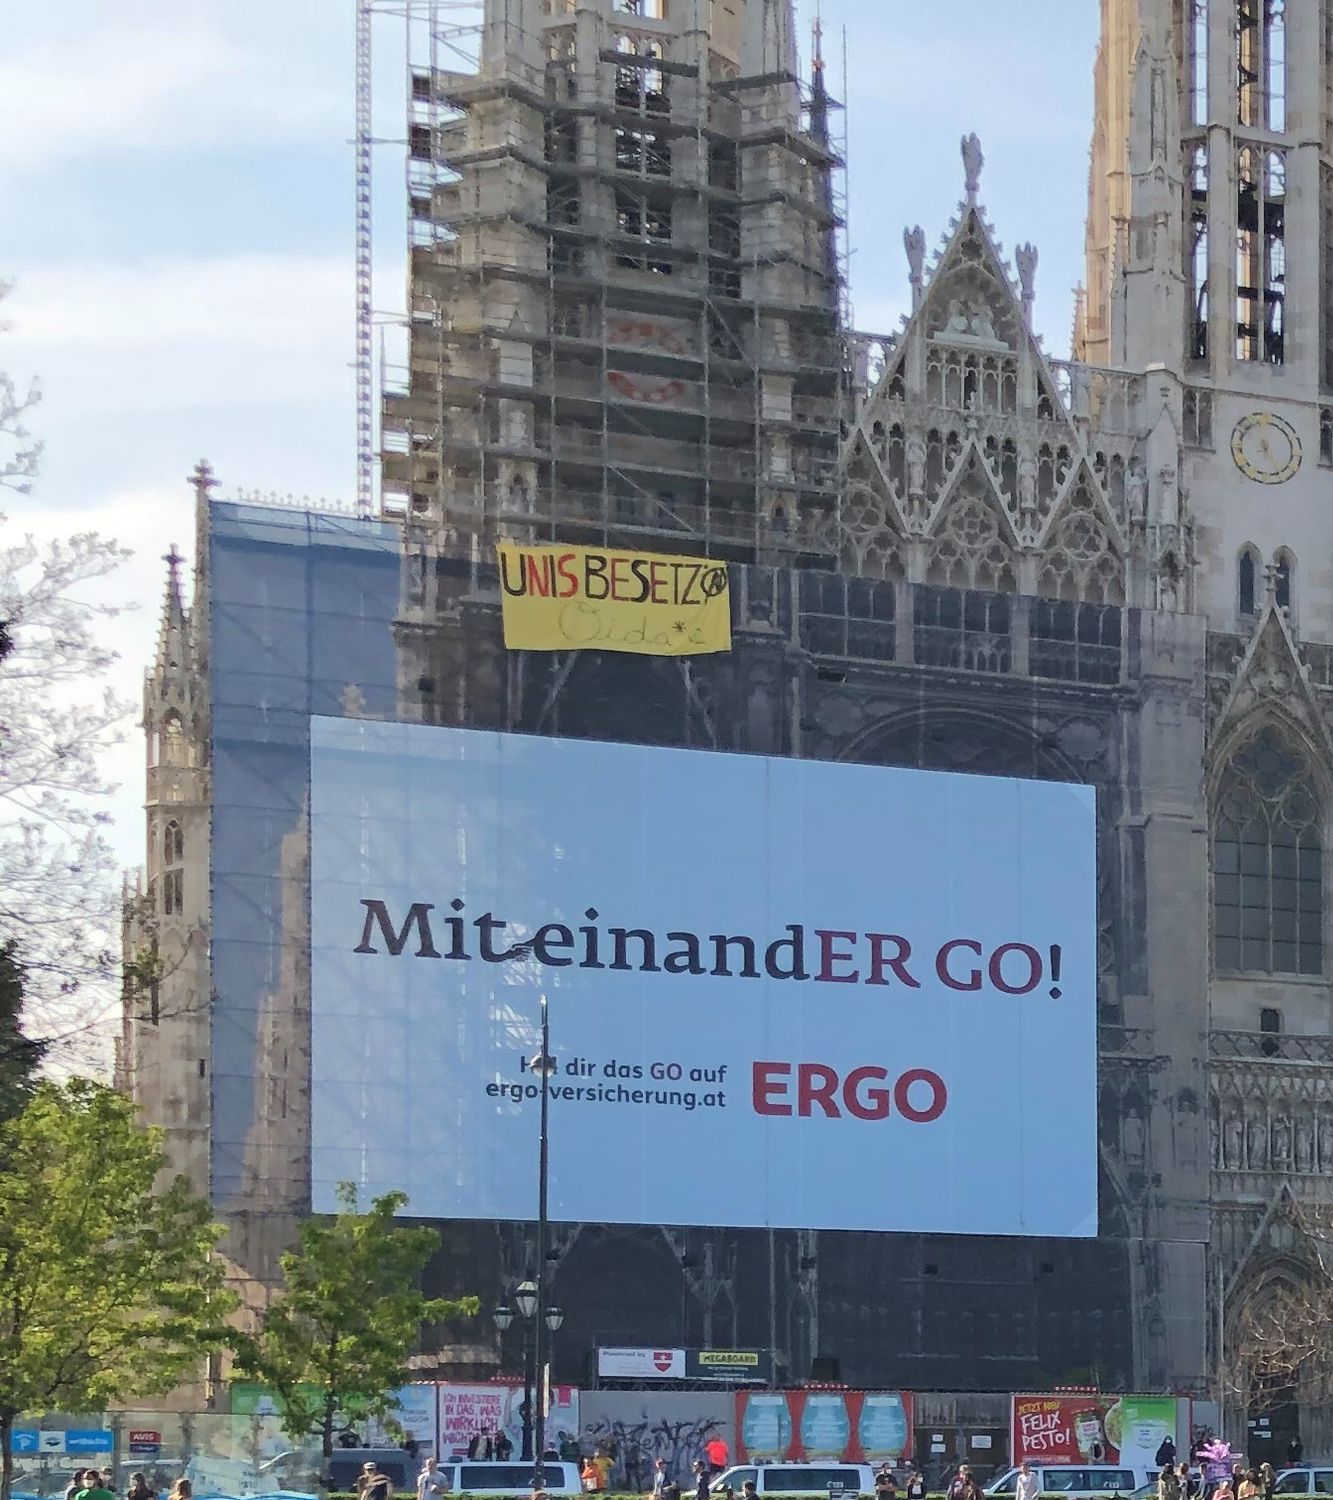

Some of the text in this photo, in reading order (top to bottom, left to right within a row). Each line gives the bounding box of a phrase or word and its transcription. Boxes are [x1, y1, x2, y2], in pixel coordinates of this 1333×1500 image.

[353, 898, 1062, 999] MiteinandER GO!
[566, 1058, 596, 1077] dir
[603, 1060, 643, 1079] das
[650, 1063, 682, 1081] GO
[689, 1065, 727, 1083] auf
[486, 1082, 726, 1111] ergo-versicherung.at
[751, 1061, 947, 1123] ERGO
[703, 1355, 756, 1363] MEGABOARD
[480, 1405, 502, 1415] WAS
[446, 1417, 499, 1431] WIRKLICH
[1020, 1411, 1061, 1435] FELIX
[133, 1433, 154, 1442] AVIS
[1022, 1428, 1071, 1451] PESTO!
